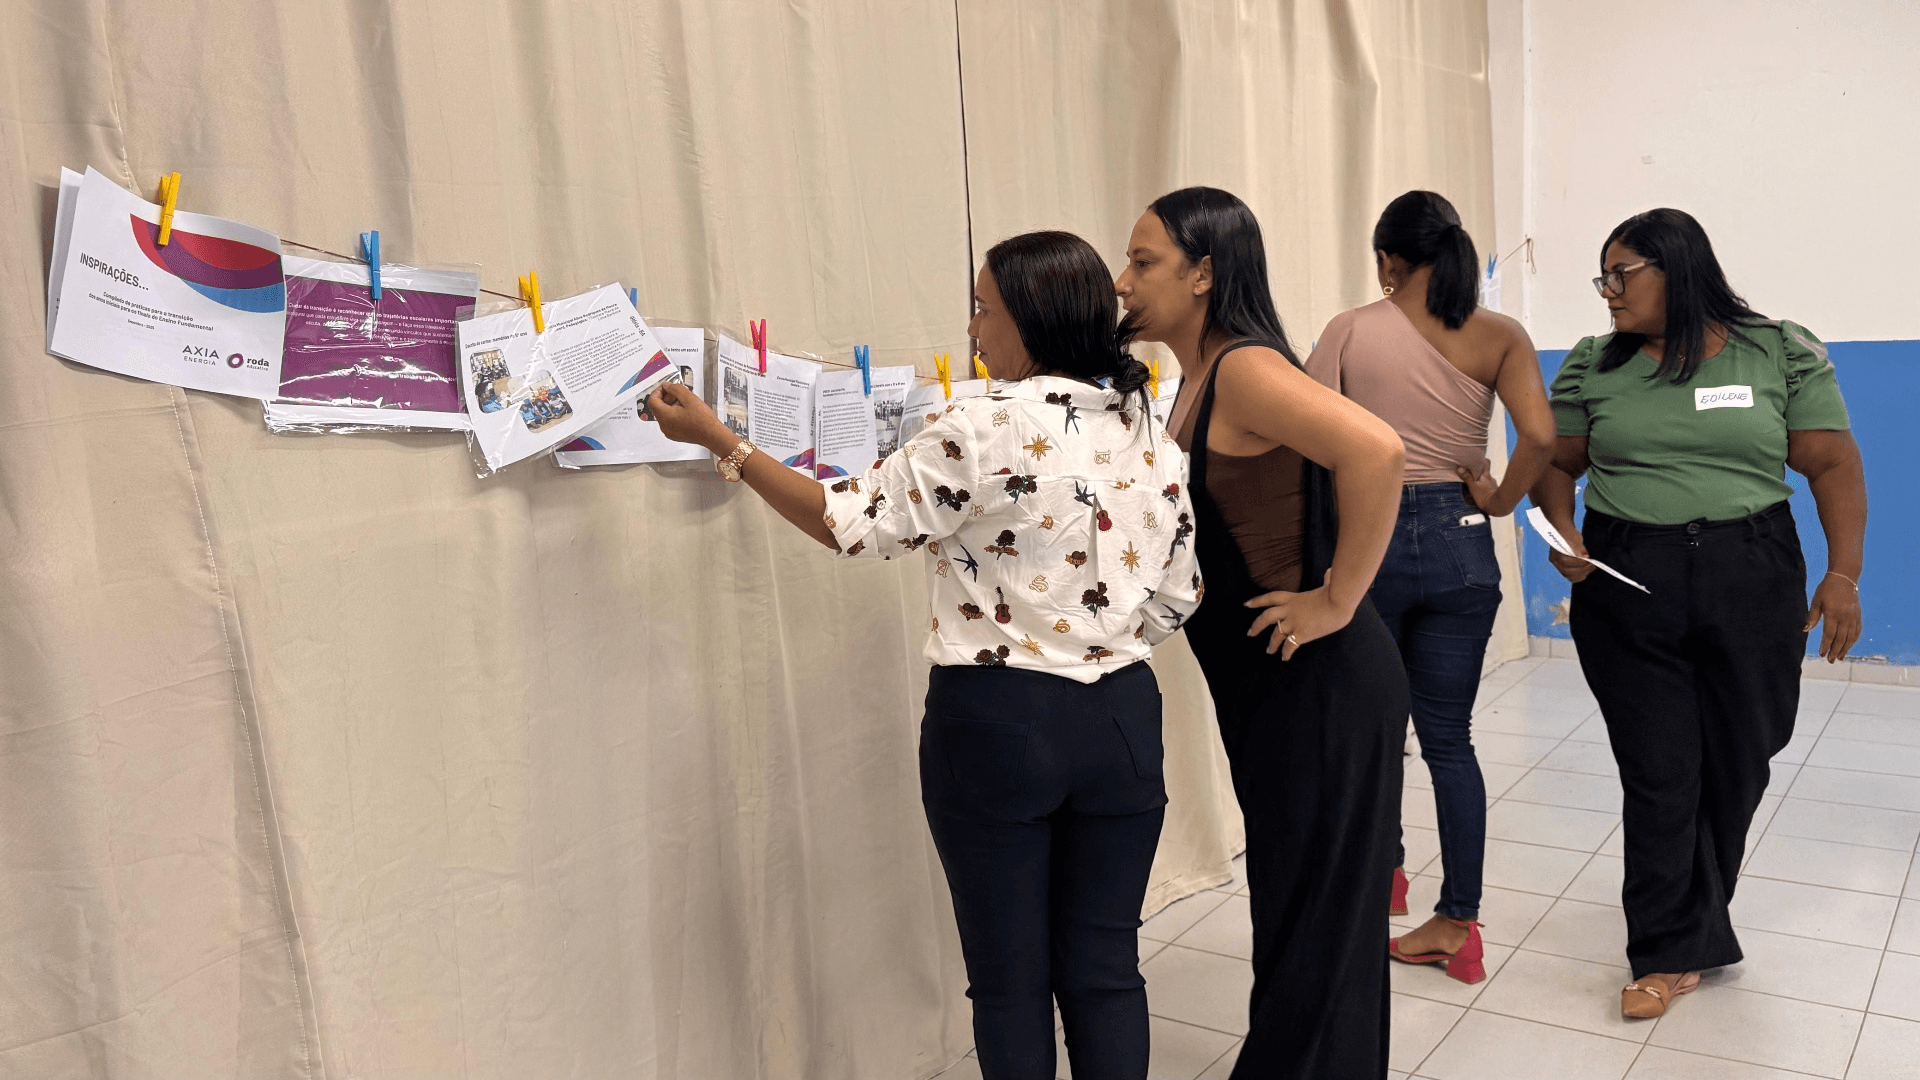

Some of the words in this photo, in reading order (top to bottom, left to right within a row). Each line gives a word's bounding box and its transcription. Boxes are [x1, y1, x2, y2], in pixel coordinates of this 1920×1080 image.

[80, 252, 149, 290] INSPIRAÇÕES...
[182, 344, 220, 360] AXIA
[184, 356, 216, 366] ENERGIA
[246, 358, 270, 367] roda
[1700, 393, 1748, 404] EDILENE
